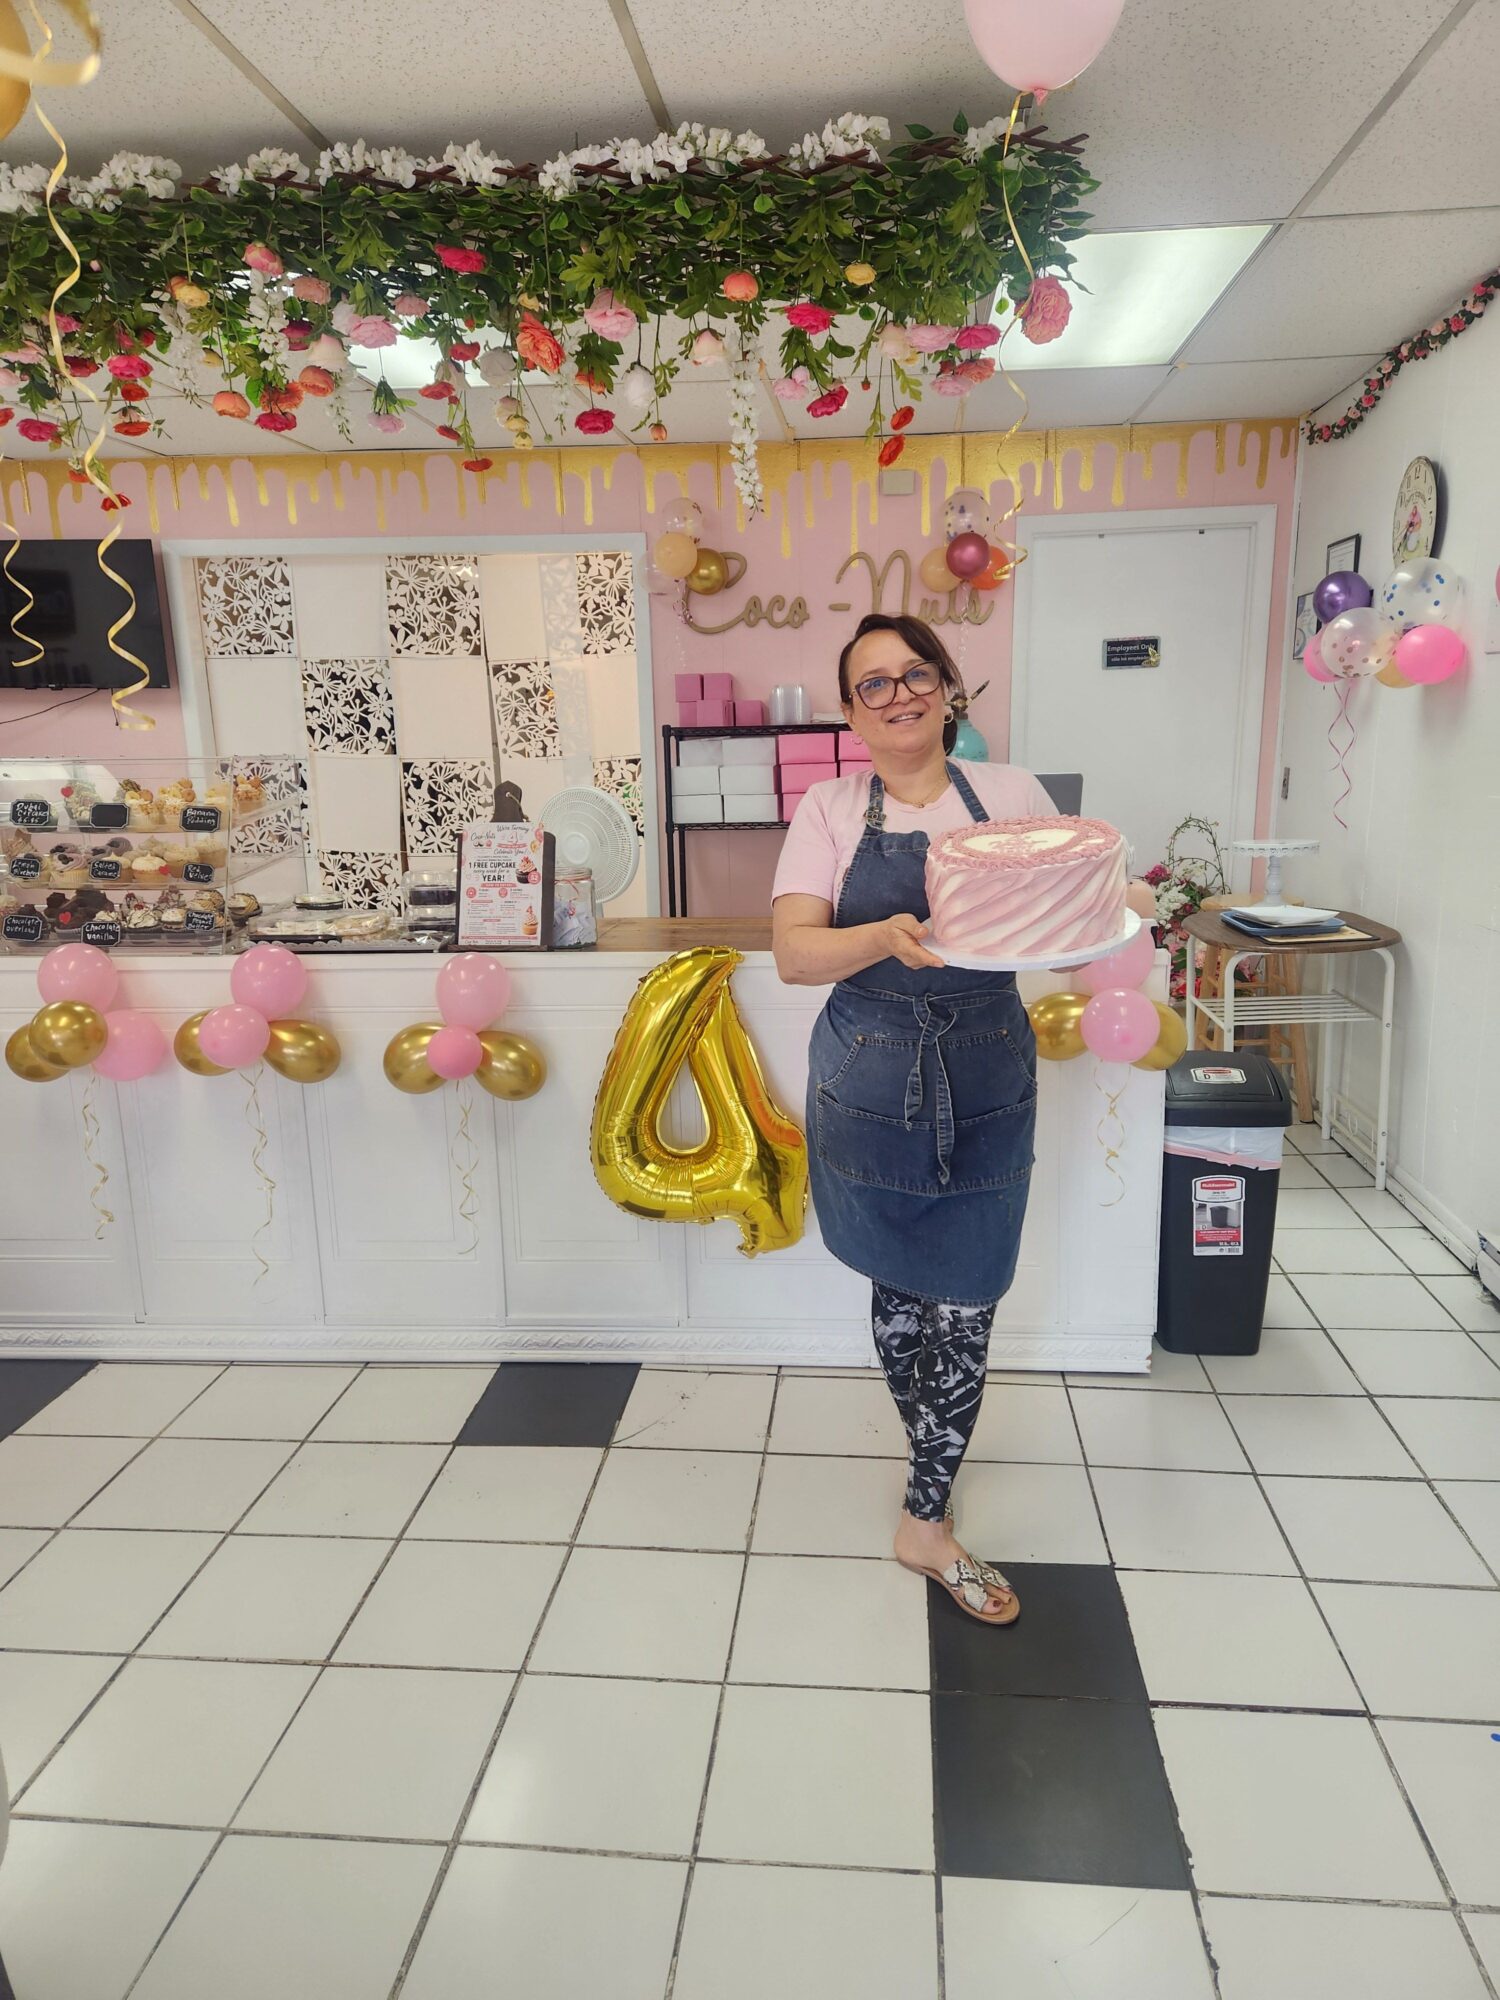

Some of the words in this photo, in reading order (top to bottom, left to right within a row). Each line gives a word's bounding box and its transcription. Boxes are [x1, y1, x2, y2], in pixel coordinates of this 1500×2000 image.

[16, 803, 42, 812] Dubai
[185, 809, 215, 818] Banana
[94, 861, 116, 869] Salted
[7, 917, 38, 926] Chocolate
[589, 945, 808, 1257] 4
